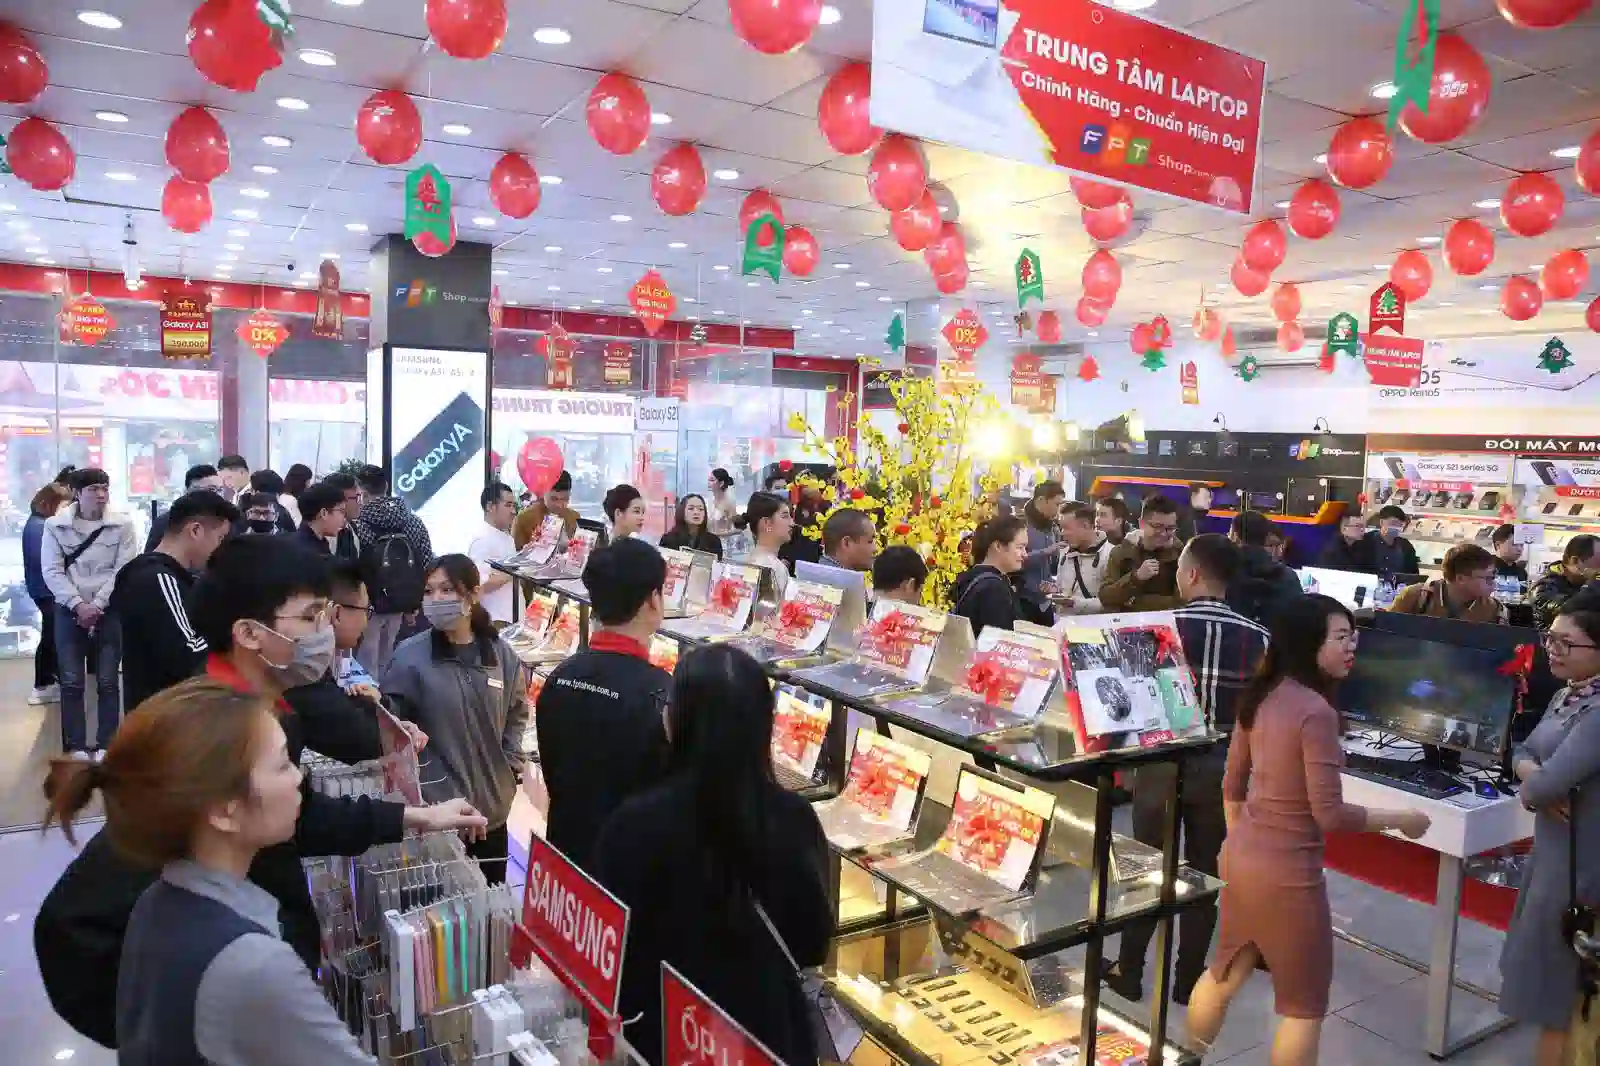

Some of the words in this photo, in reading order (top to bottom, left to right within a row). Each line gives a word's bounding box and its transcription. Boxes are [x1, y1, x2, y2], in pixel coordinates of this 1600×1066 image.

[1023, 28, 1108, 75] TRUNG
[1116, 57, 1165, 96] TÂM
[1171, 78, 1248, 120] LAPTOP
[1082, 126, 1151, 163] FPT
[639, 406, 667, 424] Galaxy
[1526, 438, 1573, 451] MÁY
[1417, 461, 1445, 472] Galaxy
[1460, 463, 1485, 472] series
[1486, 464, 1499, 472] 5G
[529, 861, 617, 981] SAMSUNG
